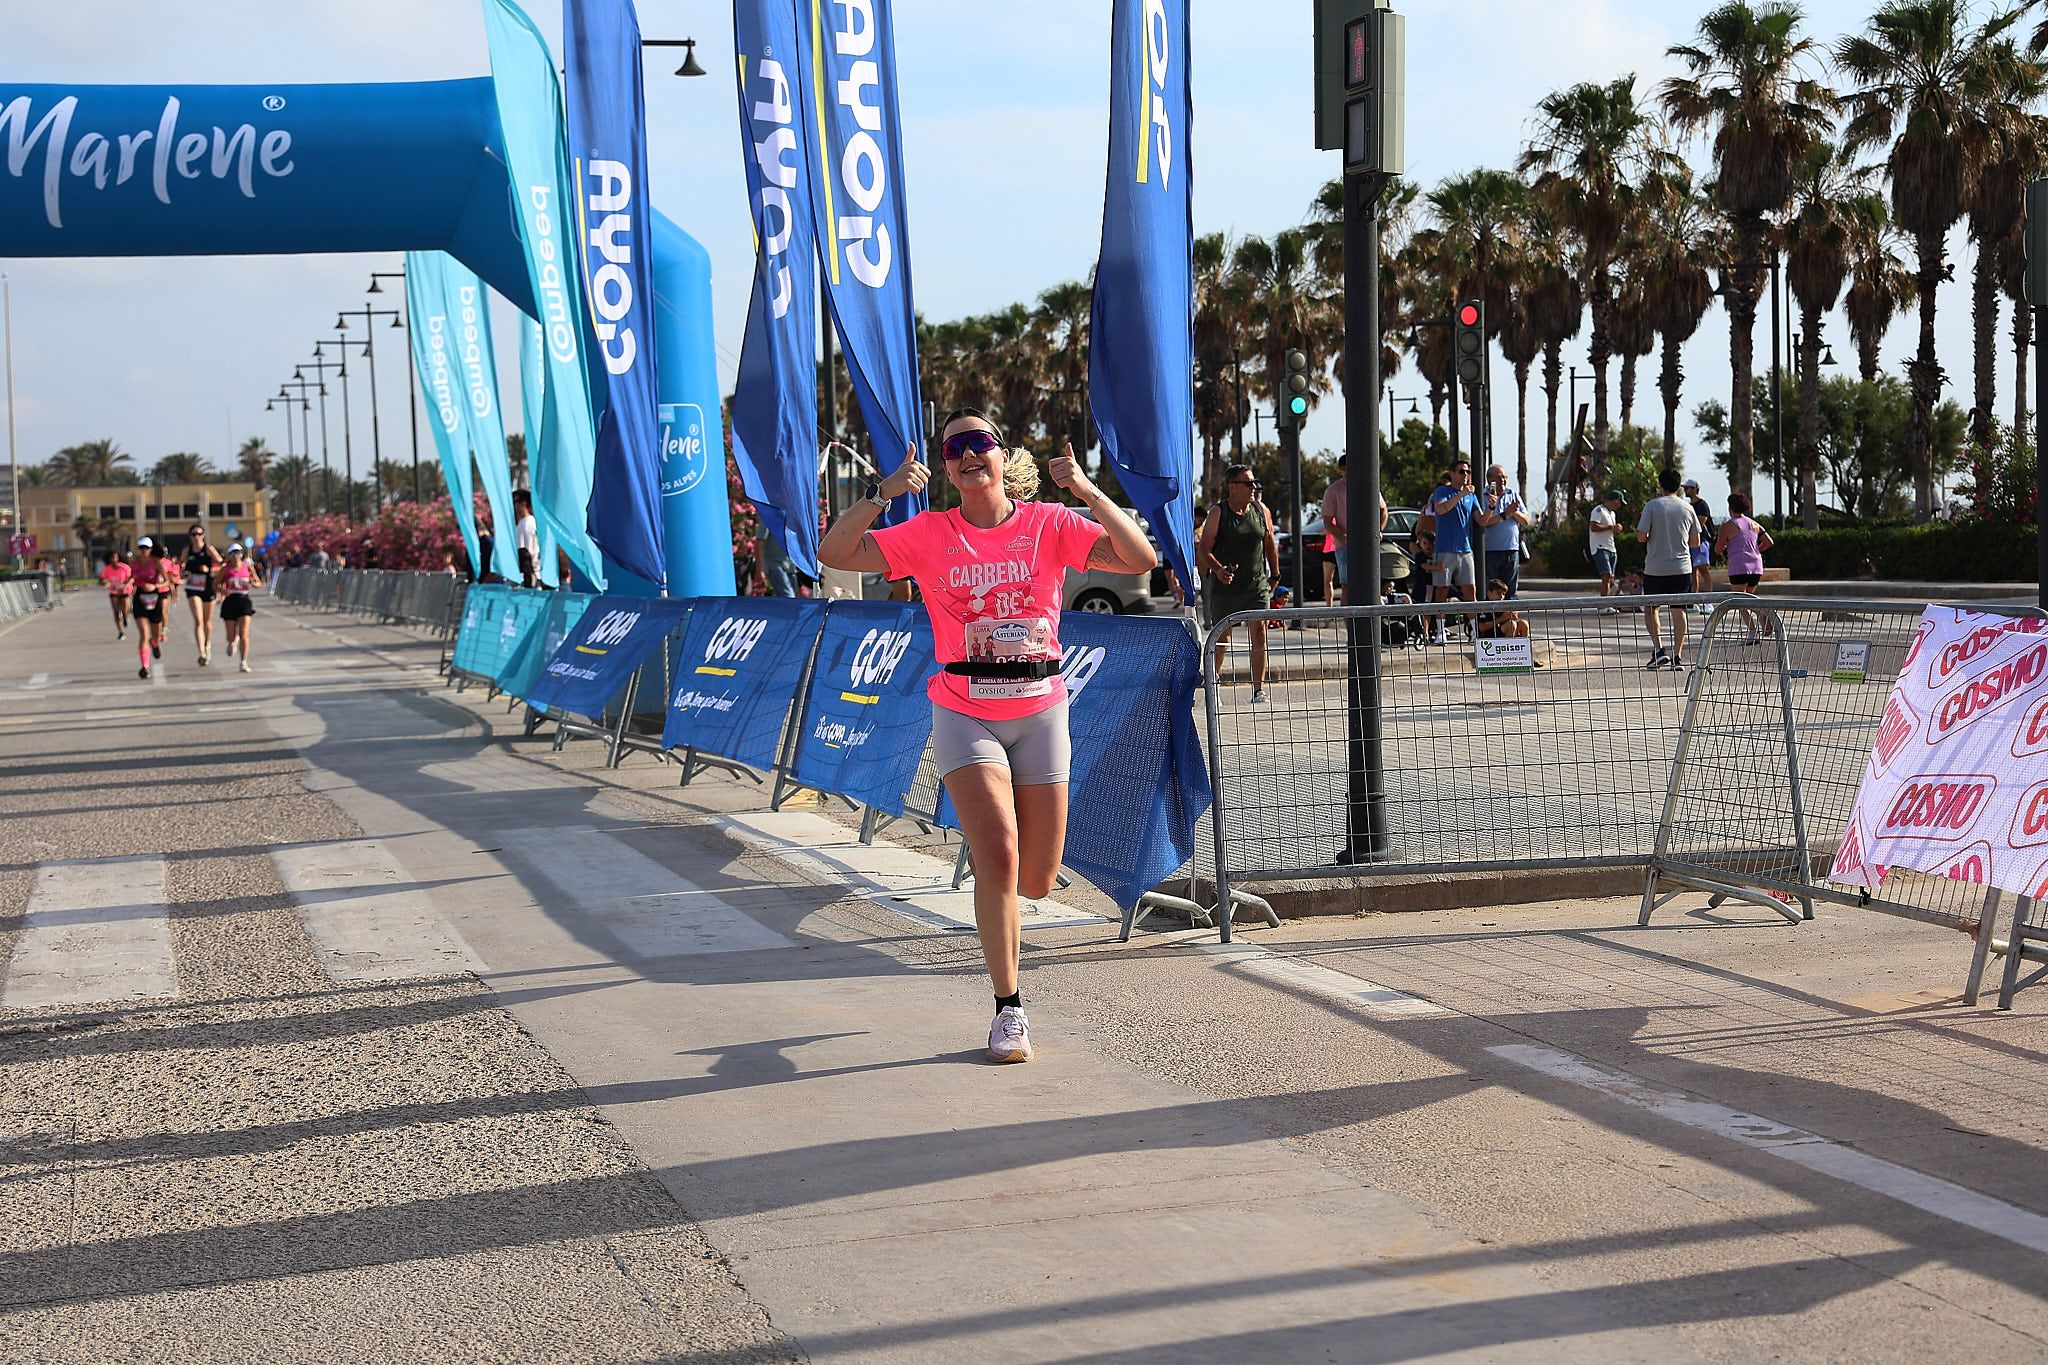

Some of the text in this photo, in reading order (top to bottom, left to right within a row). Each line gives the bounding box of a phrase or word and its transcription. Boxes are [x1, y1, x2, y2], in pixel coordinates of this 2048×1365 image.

[0, 95, 295, 228] Marlene
[660, 424, 701, 463] lene
[673, 469, 698, 489] ALPES
[995, 592, 1023, 617] DE
[586, 609, 641, 645] GOYA
[704, 616, 767, 663] GOYA
[850, 628, 912, 688] GOYA
[978, 687, 1006, 695] OYSHO
[1938, 645, 2048, 733] COSMO
[1886, 782, 1985, 830] COSMO
